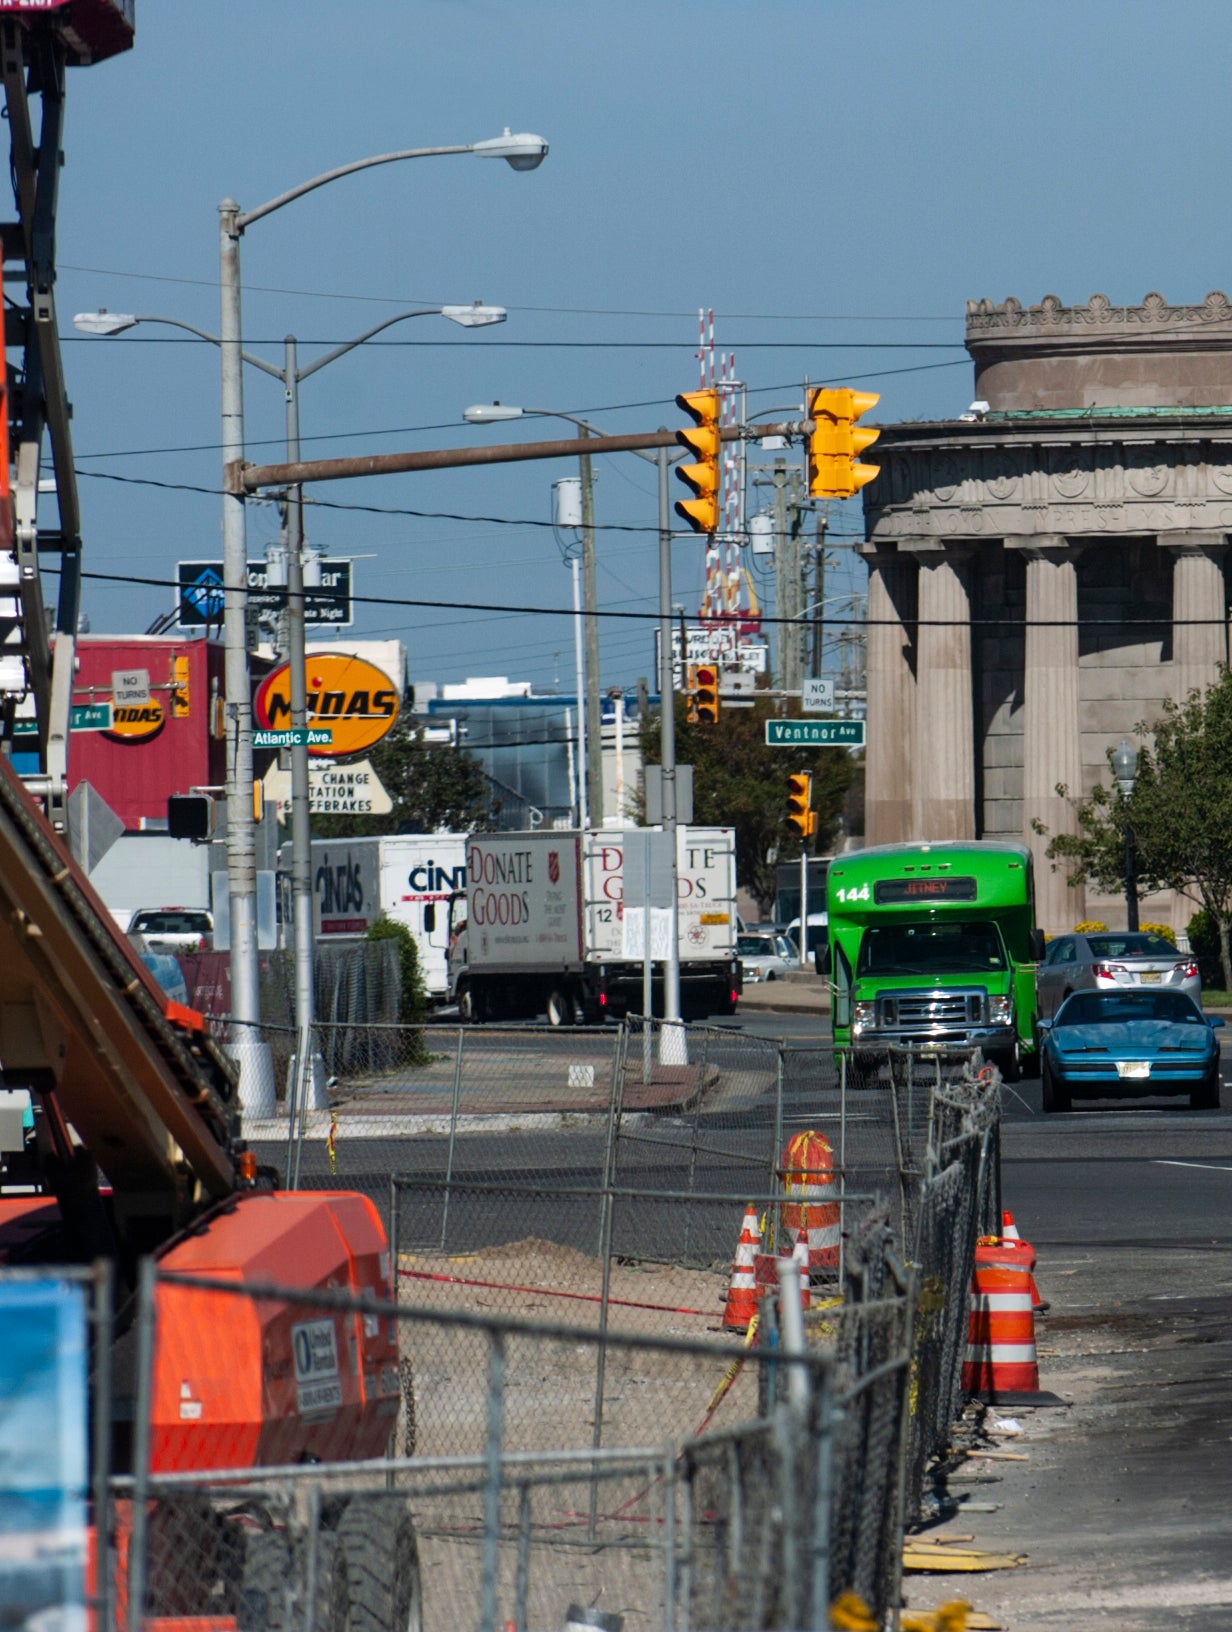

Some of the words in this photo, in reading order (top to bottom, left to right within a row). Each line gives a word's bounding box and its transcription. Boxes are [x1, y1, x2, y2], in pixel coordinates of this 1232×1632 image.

[123, 676, 137, 685] NO
[116, 690, 147, 700] TURNS
[811, 684, 826, 693] NO
[805, 698, 832, 707] TURNS
[85, 711, 102, 720] Ave
[113, 708, 162, 722] IDAS
[254, 732, 302, 745] Atlantic
[306, 731, 333, 744] Ave.
[775, 726, 836, 739] Ventnor
[840, 726, 856, 735] Ave
[322, 773, 369, 785] CHANGE
[309, 786, 354, 798] TATION
[310, 800, 372, 812] FFBRAKES
[471, 846, 533, 885] DONATE
[601, 847, 715, 871] DTE
[408, 859, 467, 892] CINT
[603, 875, 706, 900] GDS
[904, 881, 948, 894] JITNEY
[836, 888, 869, 903] 144
[472, 887, 529, 926] GOODS
[597, 909, 612, 922] 12
